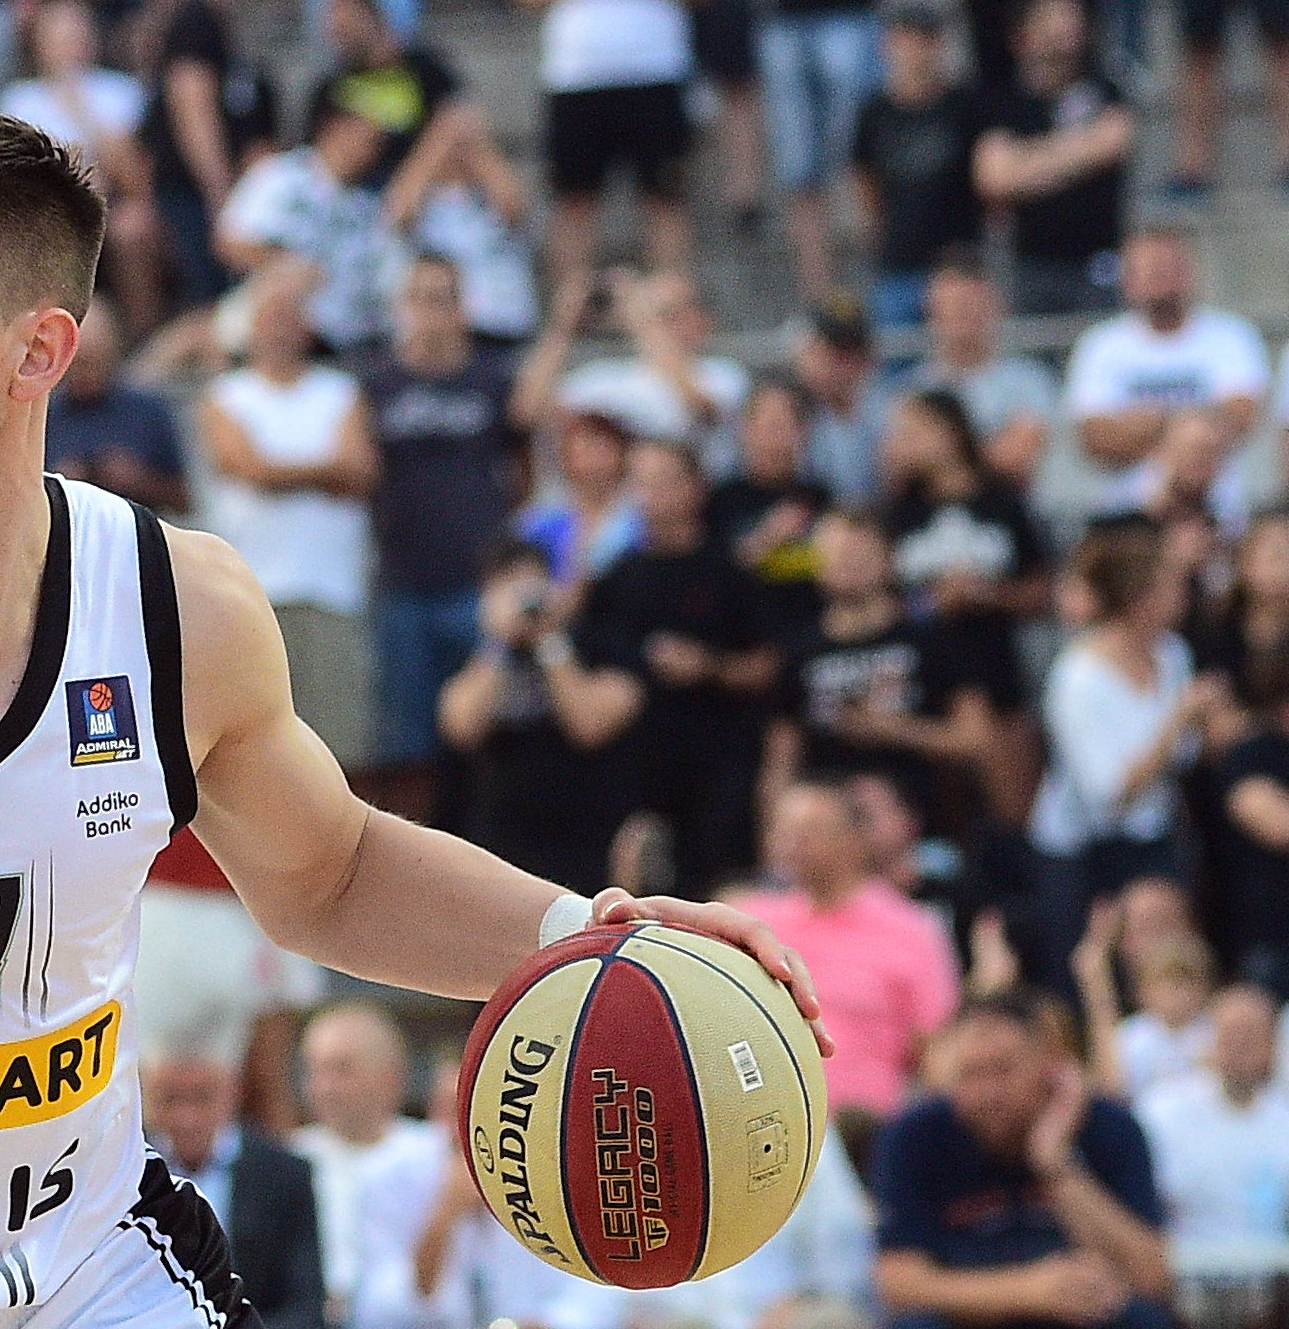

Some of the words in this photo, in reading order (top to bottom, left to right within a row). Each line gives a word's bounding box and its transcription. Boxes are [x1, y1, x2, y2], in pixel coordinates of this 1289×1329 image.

[89, 712, 114, 736] ABA
[75, 737, 137, 755] ADMIRAL
[76, 792, 140, 818] Addiko
[86, 814, 133, 838] Bank
[499, 1034, 574, 1265] SPALDING
[590, 1067, 644, 1263] LEGACY
